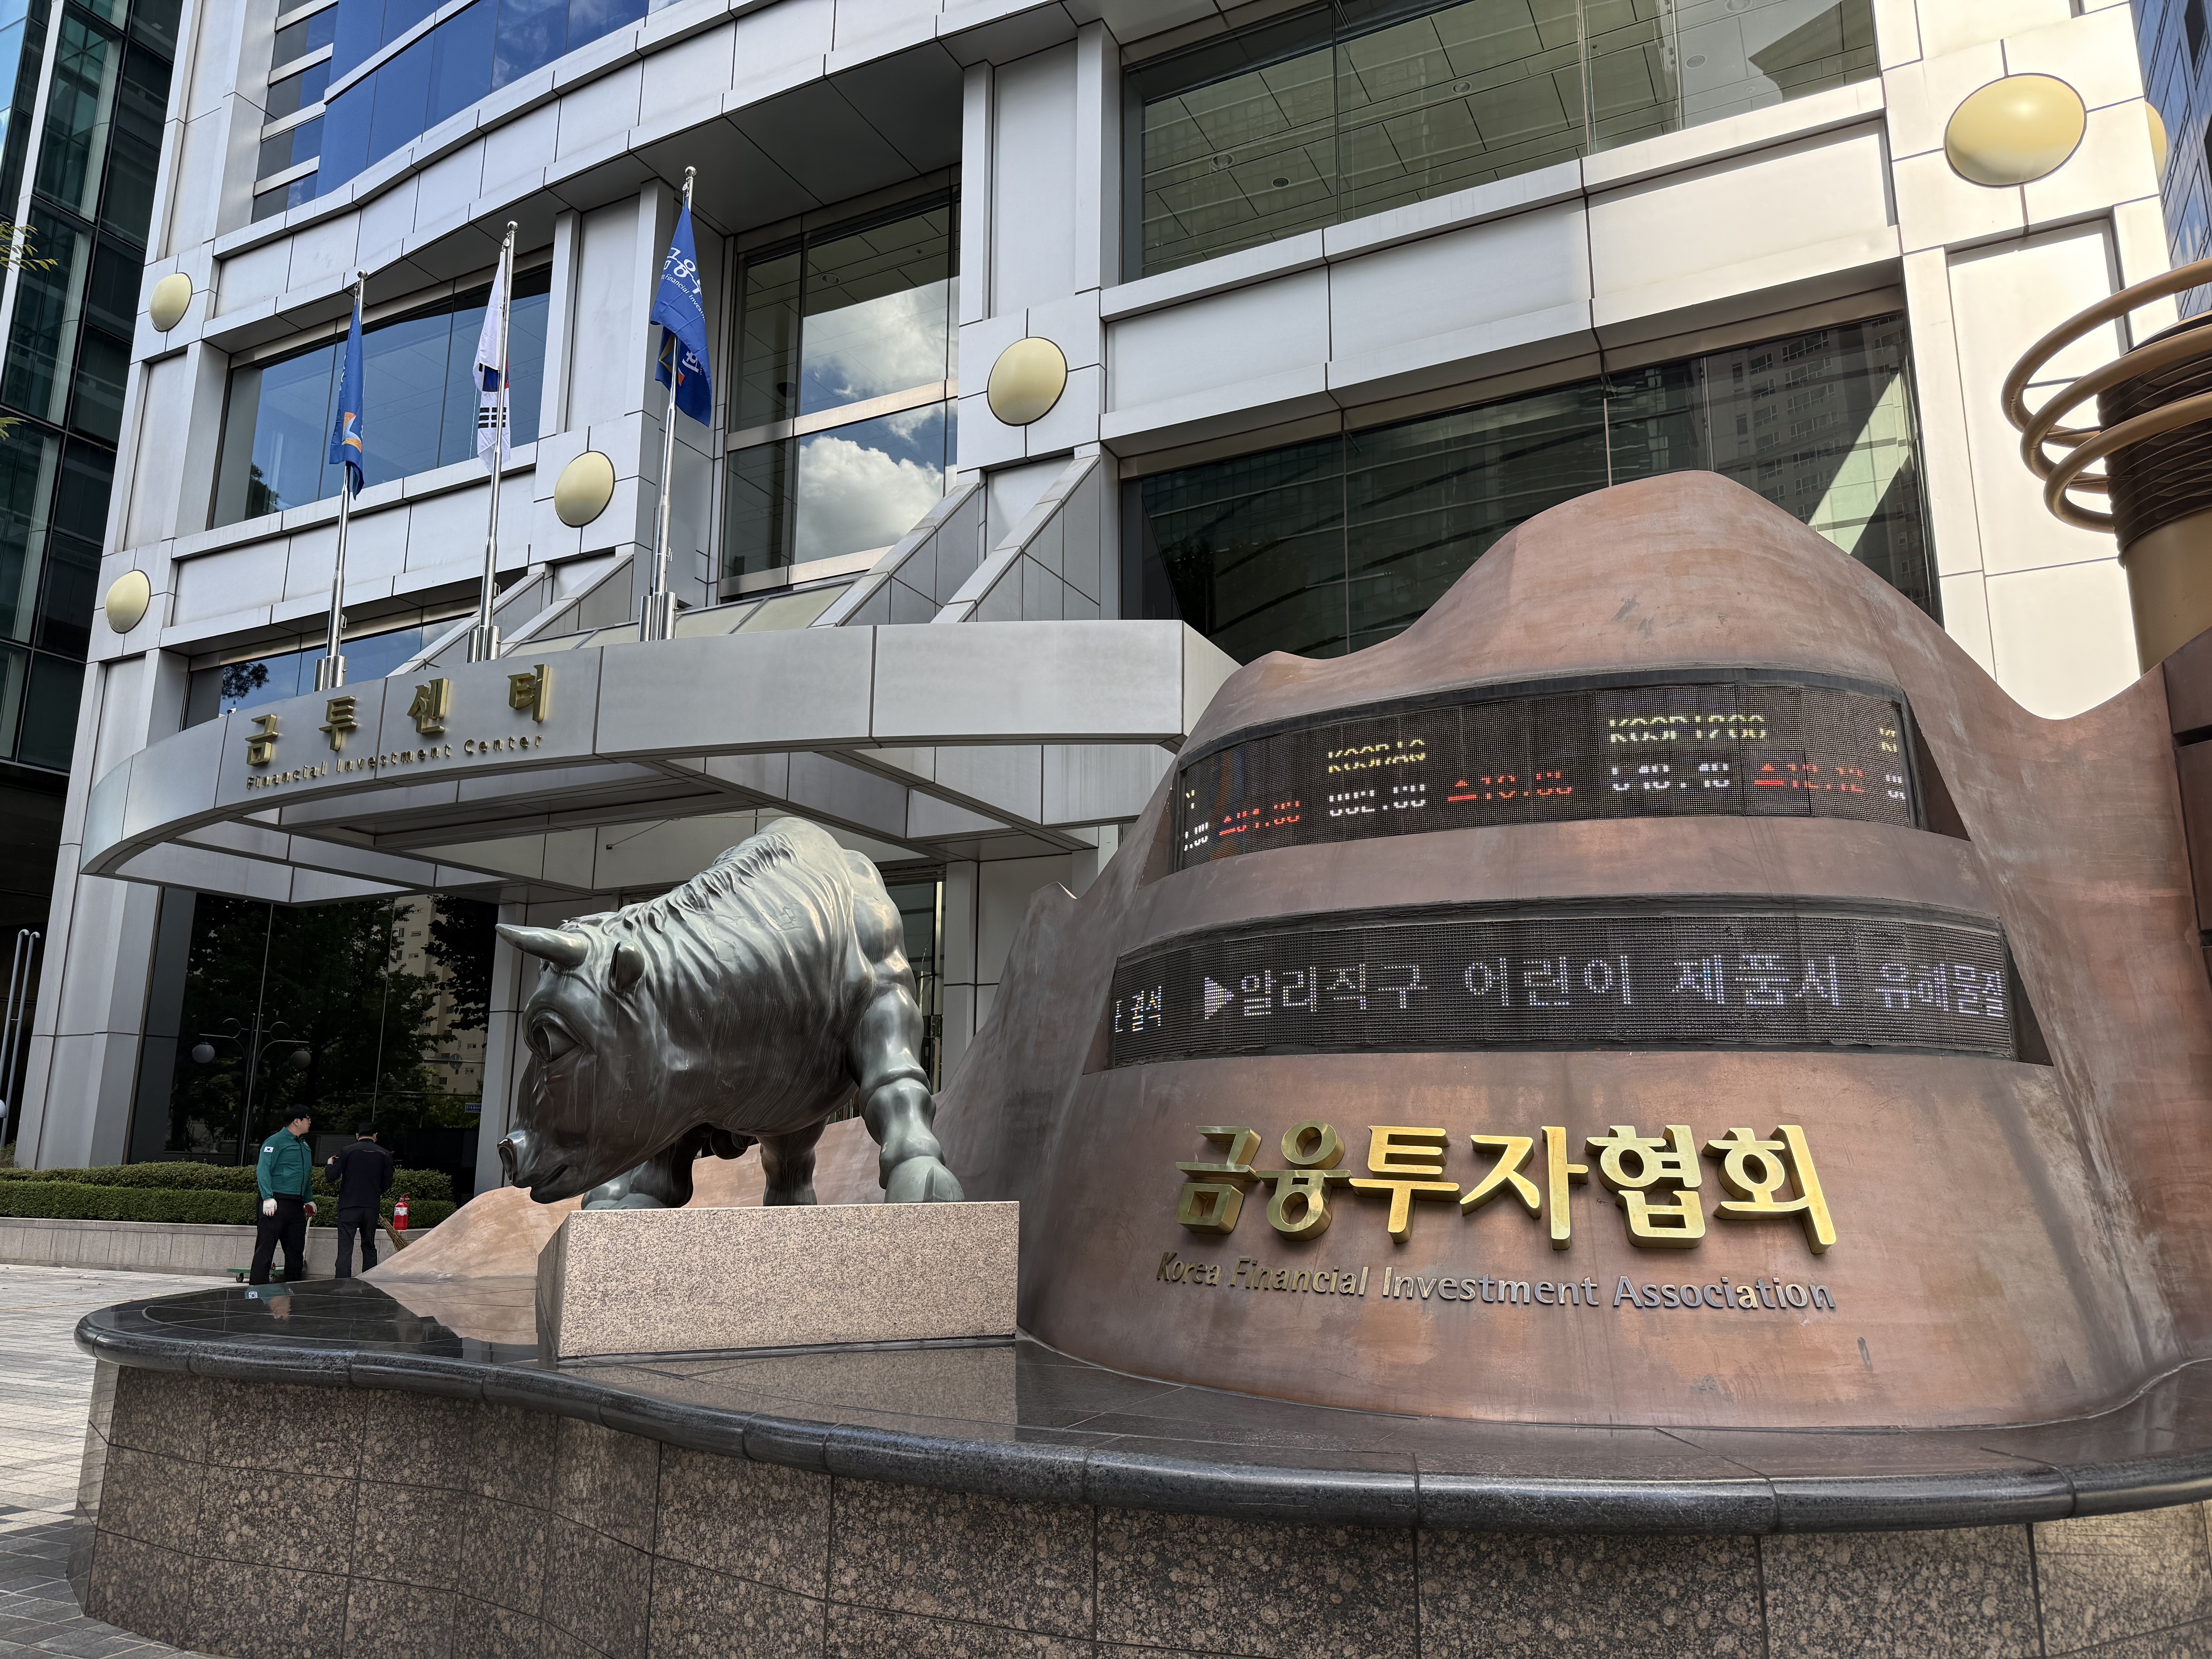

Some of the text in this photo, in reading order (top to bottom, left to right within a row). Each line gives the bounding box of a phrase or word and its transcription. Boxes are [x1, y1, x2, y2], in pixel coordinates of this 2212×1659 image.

[246, 734, 542, 790] Financial Investment Center
[1241, 963, 1428, 1017] 알리직구
[1465, 955, 1632, 1007] 어린이
[1672, 954, 1839, 1006] 제품서
[1175, 1121, 1837, 1254] 금융투자협회
[1156, 1251, 1836, 1309] Korea Financial Investment Association
